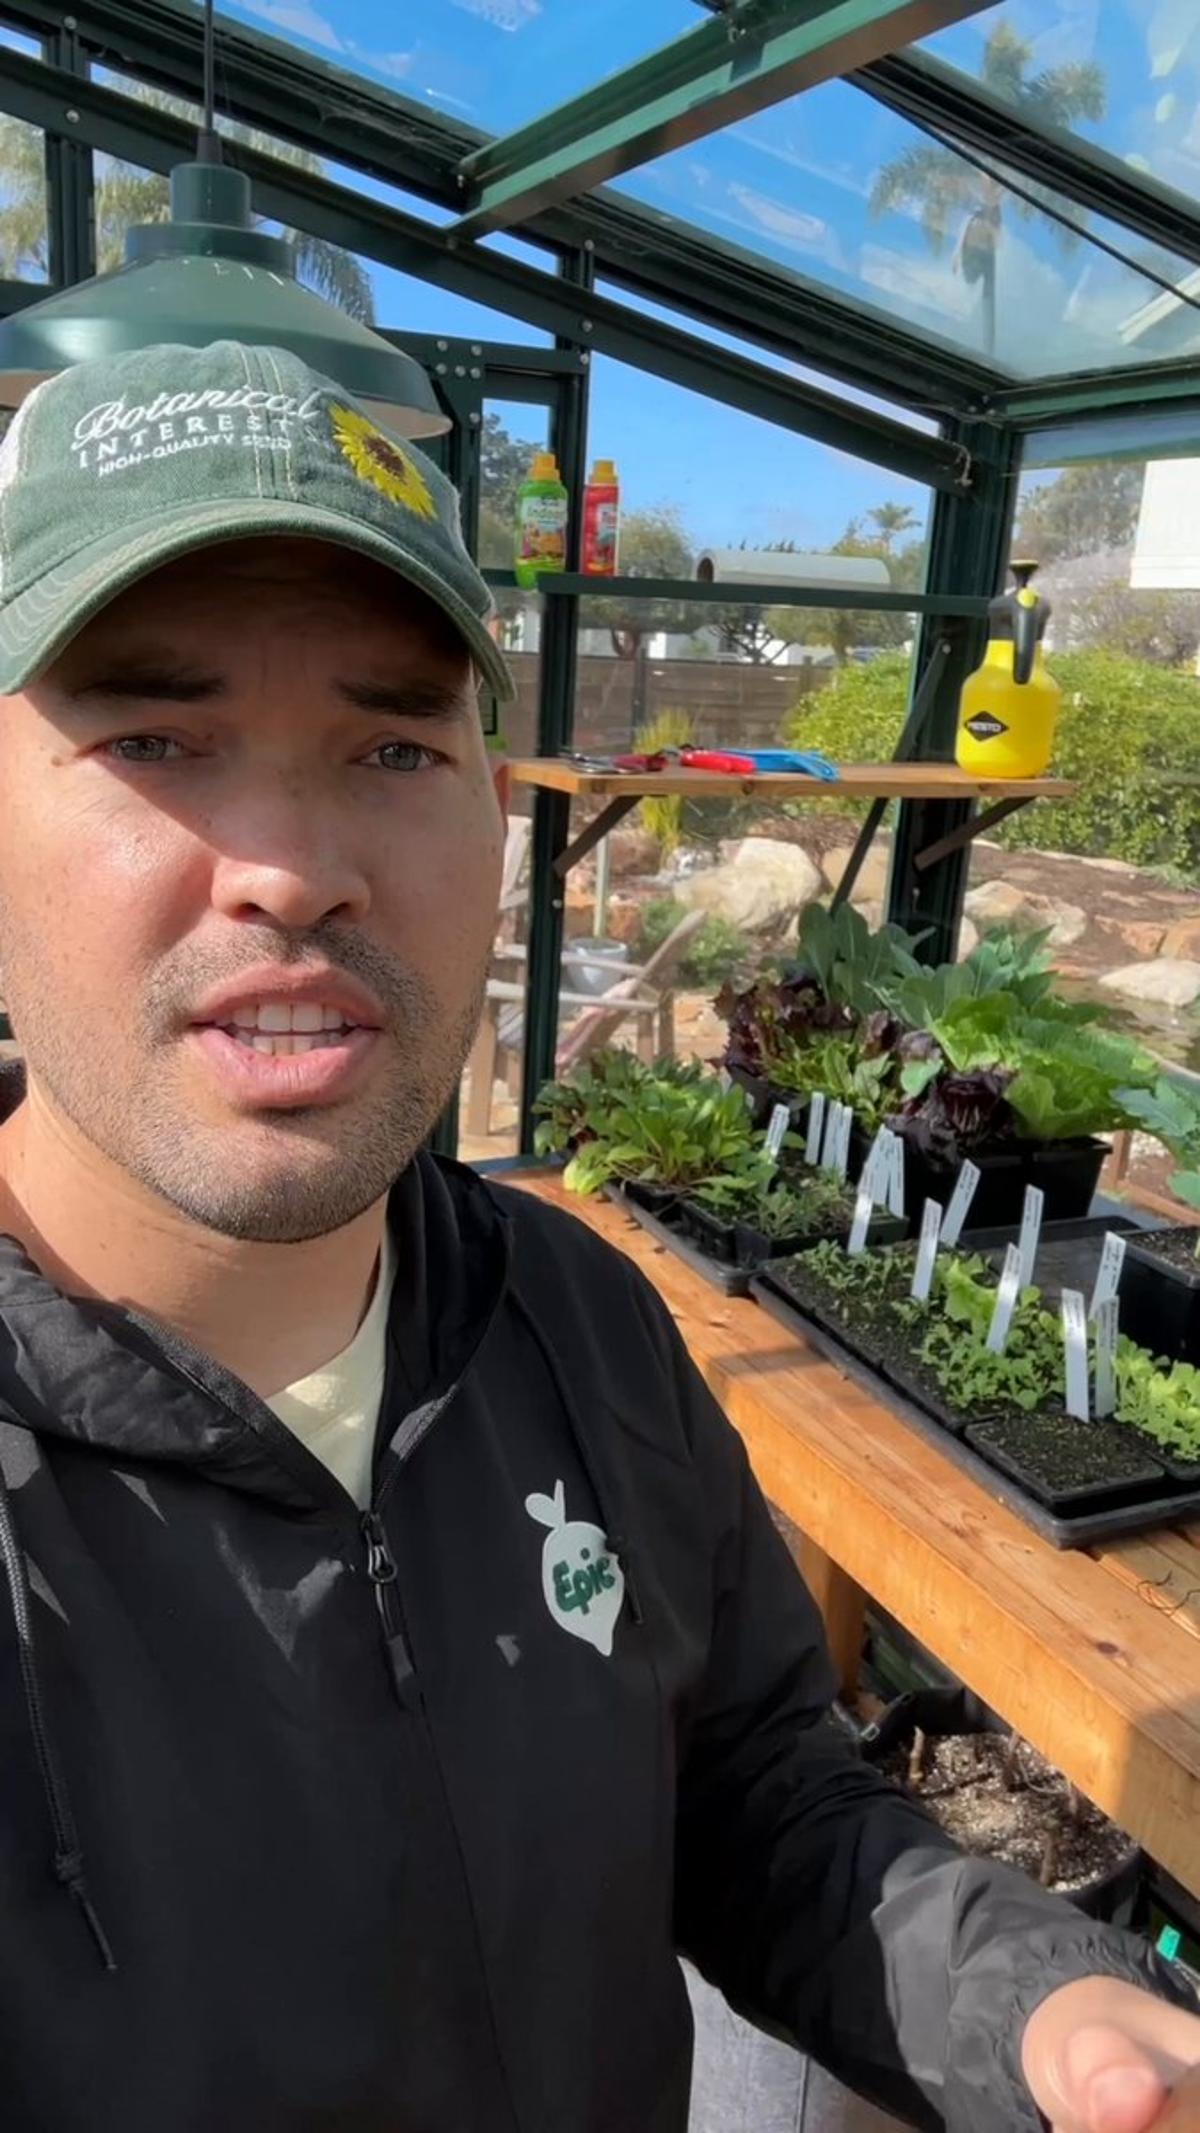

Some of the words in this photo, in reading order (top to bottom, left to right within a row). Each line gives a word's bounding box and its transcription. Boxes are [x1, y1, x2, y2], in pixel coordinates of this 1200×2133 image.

[70, 385, 321, 450] Botanical
[99, 433, 234, 477] HIGH-QUALITY
[552, 1547, 616, 1615] Epic
